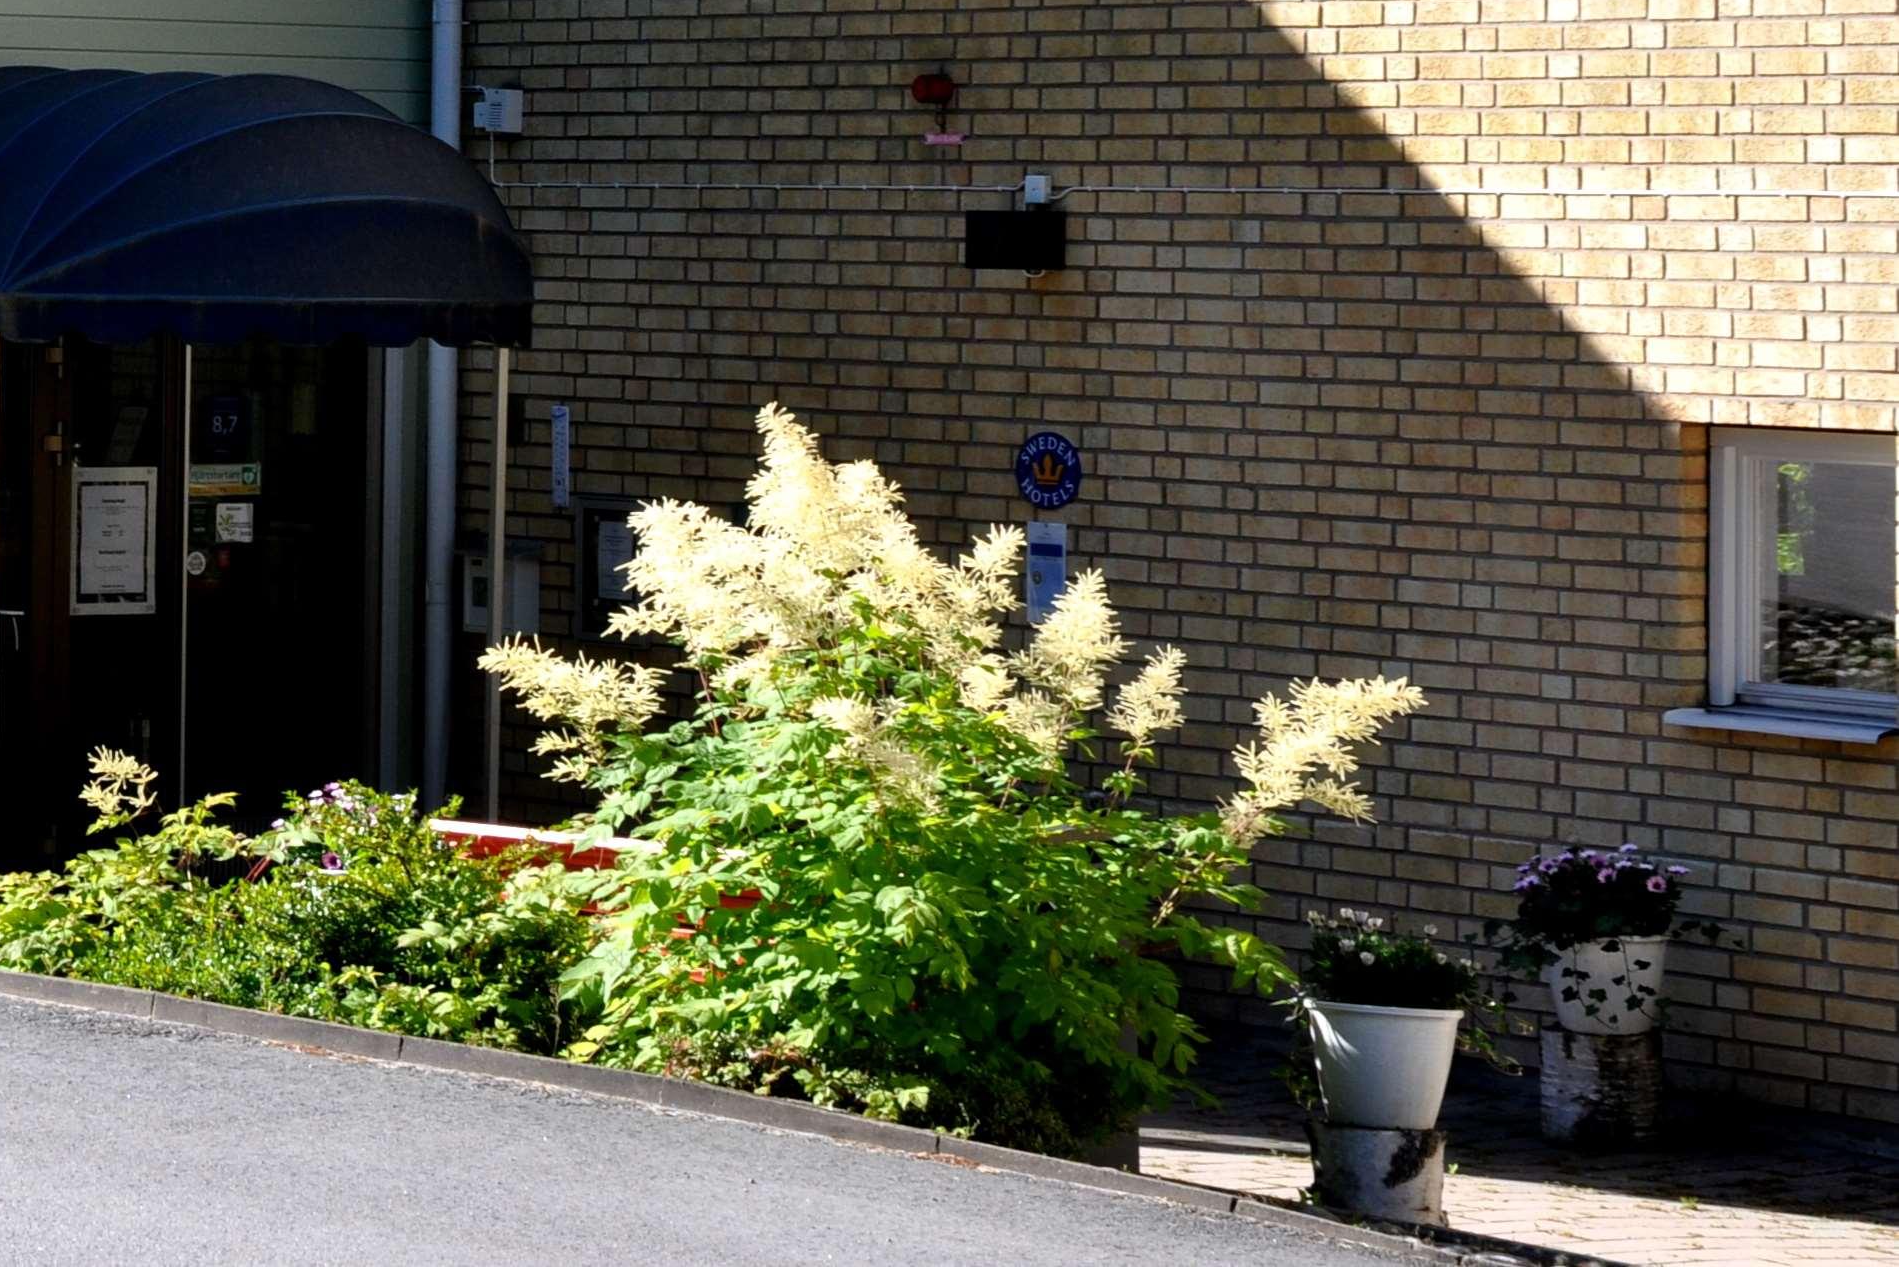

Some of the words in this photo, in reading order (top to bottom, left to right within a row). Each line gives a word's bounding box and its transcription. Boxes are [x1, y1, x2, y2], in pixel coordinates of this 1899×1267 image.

[212, 414, 239, 436] 8,7
[1021, 436, 1076, 467] SWEDEN
[1021, 477, 1075, 507] HOTELS
